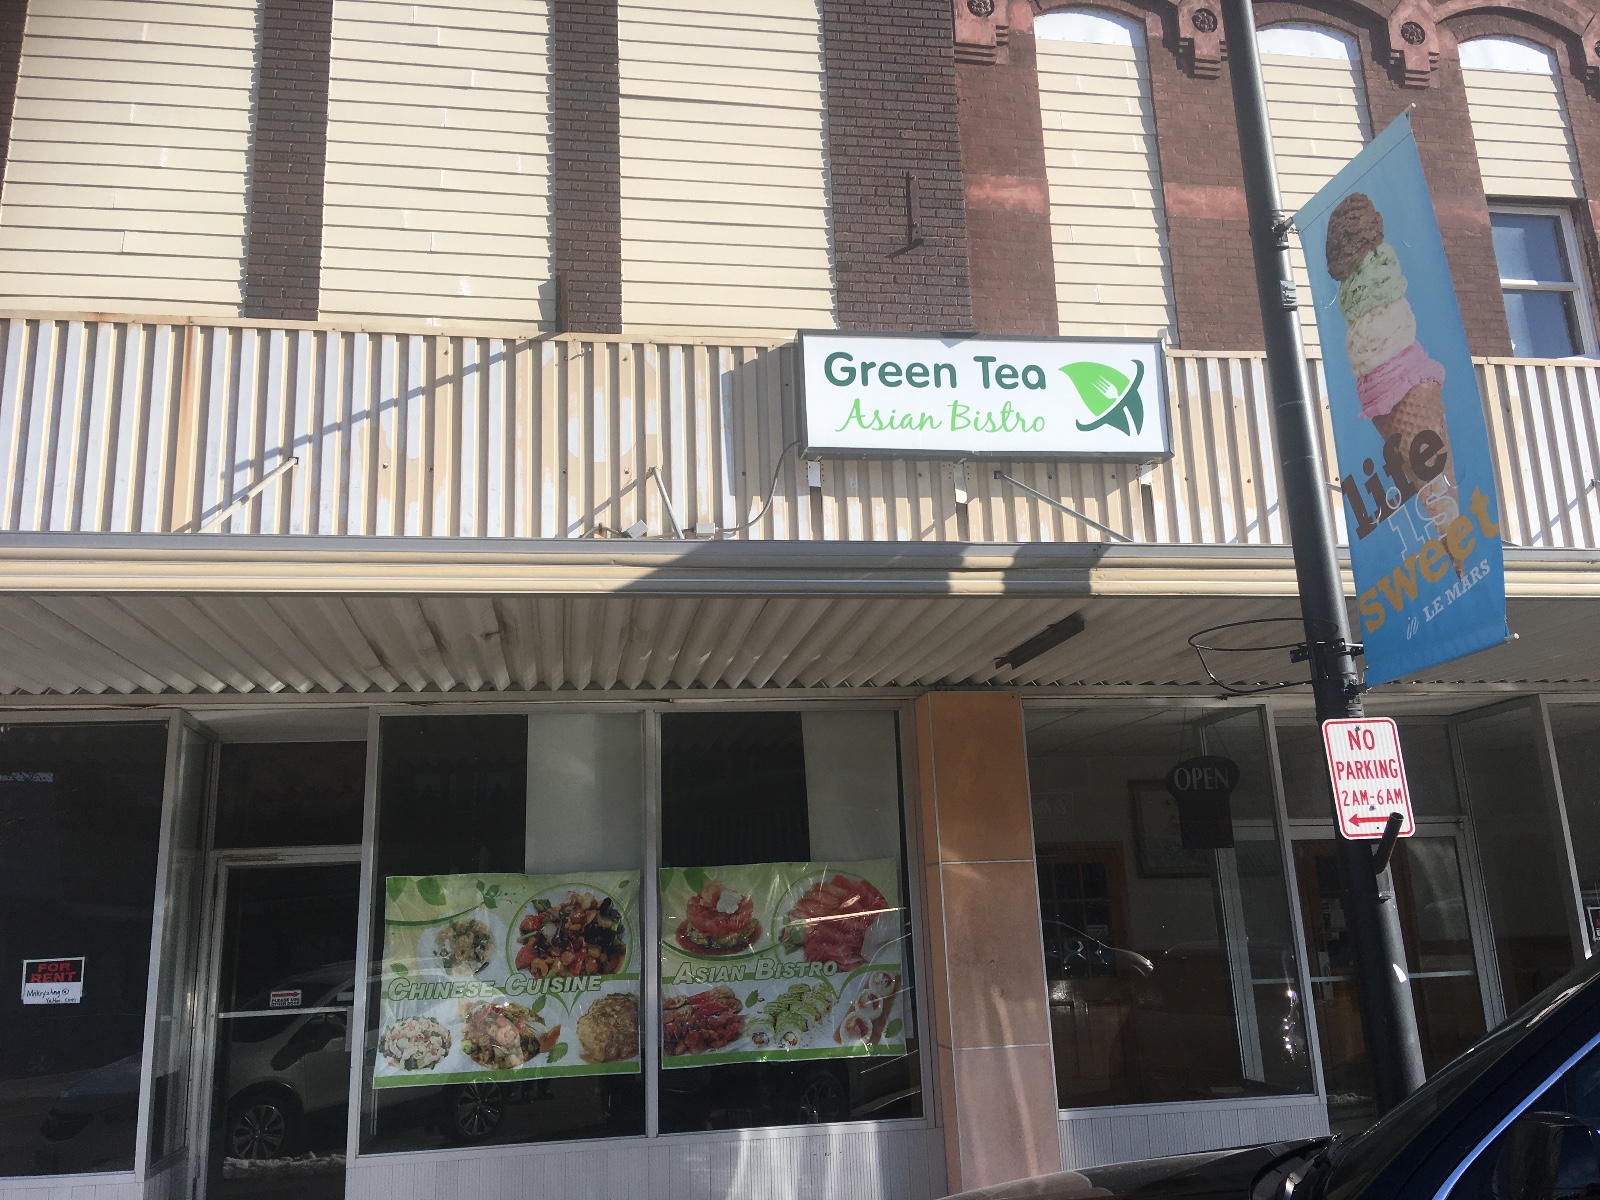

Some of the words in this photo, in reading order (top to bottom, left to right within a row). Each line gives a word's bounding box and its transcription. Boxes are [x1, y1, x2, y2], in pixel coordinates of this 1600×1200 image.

[823, 351, 957, 389] Green
[973, 355, 1047, 390] Tea
[834, 397, 942, 432] Asian
[946, 399, 1046, 433] Bistro
[1341, 429, 1448, 541] life
[1359, 485, 1500, 634] sweet
[1422, 597, 1444, 622] LE
[1444, 559, 1491, 606] MARS
[1347, 728, 1375, 751] NO
[1174, 767, 1230, 791] OPEN
[1335, 759, 1399, 781] PARKING
[30, 972, 76, 983] RENT
[38, 962, 71, 972] FOR
